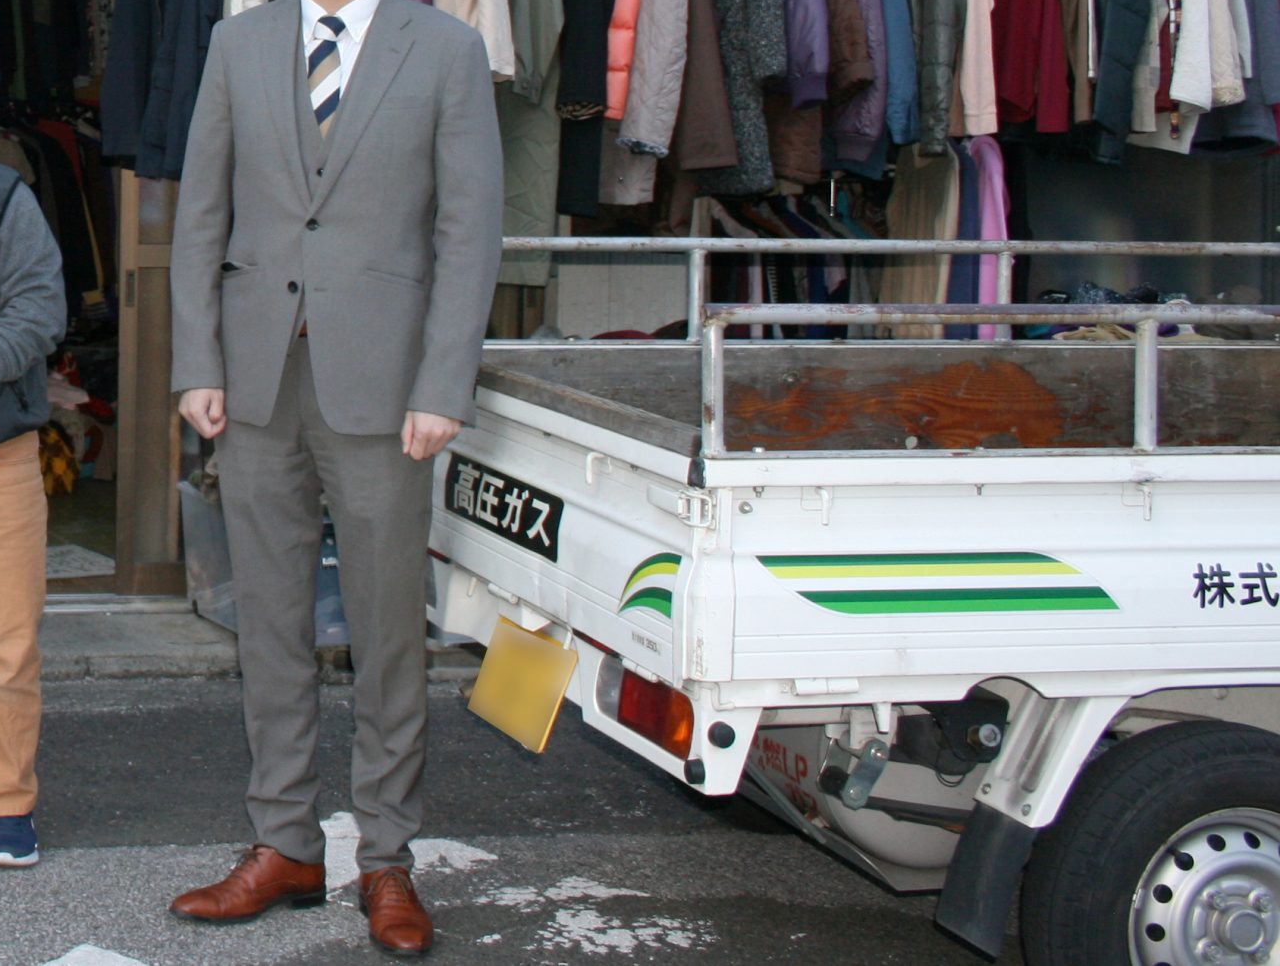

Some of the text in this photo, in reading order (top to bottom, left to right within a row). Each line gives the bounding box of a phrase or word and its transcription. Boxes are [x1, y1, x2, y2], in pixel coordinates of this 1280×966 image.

[452, 462, 551, 548] 高圧ガス
[1192, 561, 1280, 609] 株式
